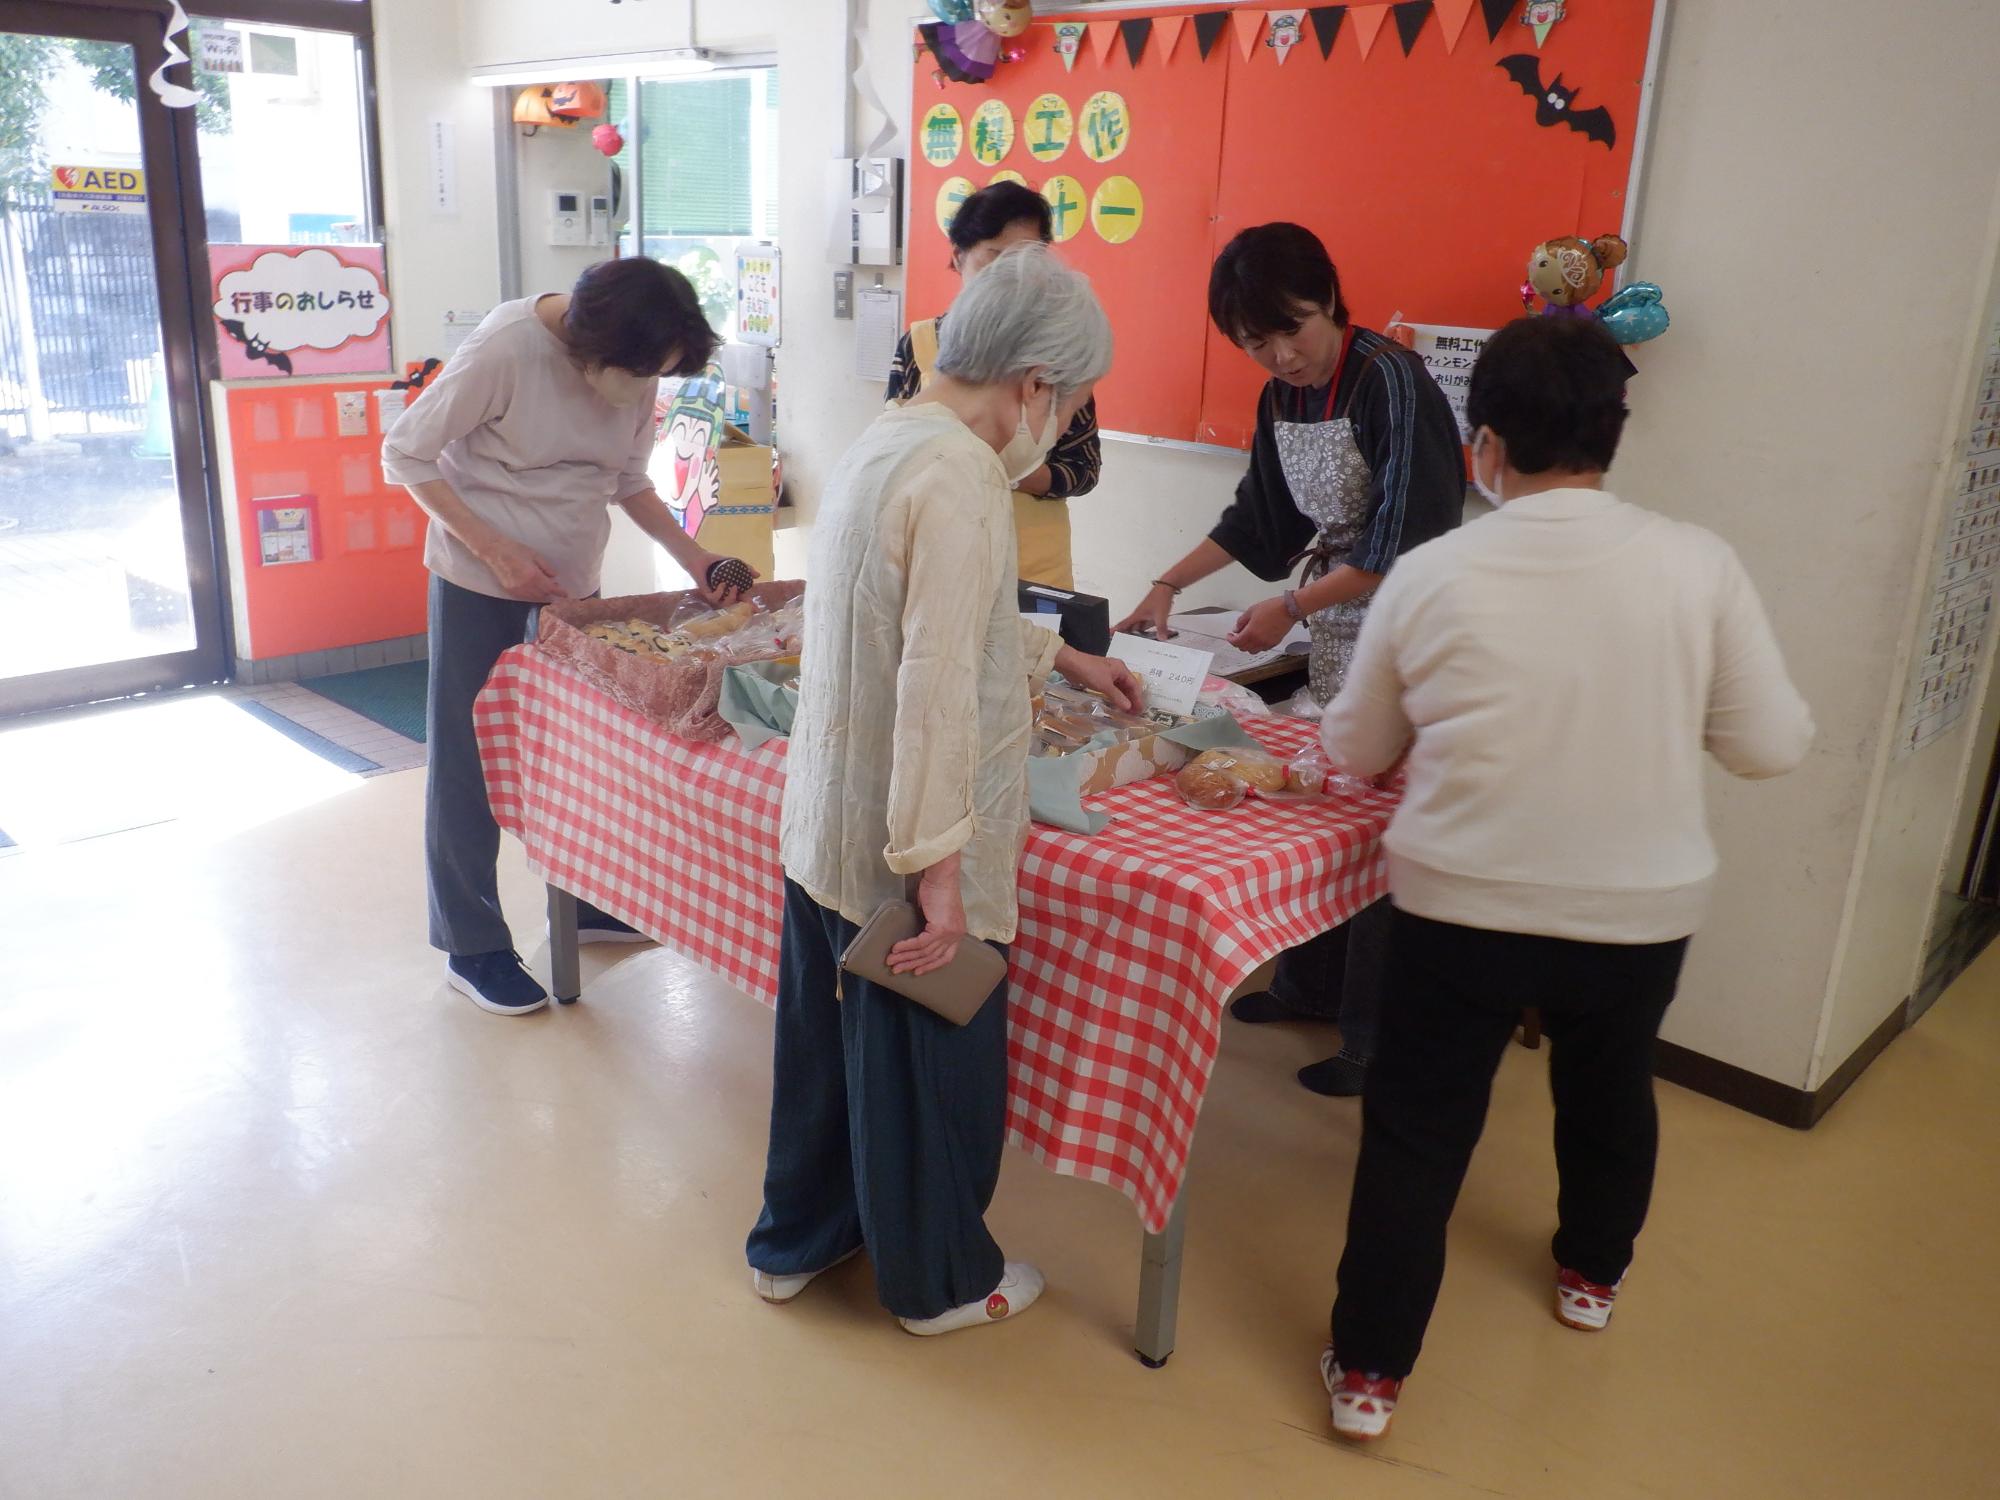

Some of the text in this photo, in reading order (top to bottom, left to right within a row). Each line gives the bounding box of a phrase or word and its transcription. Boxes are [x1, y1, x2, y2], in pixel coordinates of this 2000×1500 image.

[83, 170, 137, 190] AED
[230, 290, 375, 314] 行事のおしらせ
[1423, 354, 1481, 368] ウィンモン
